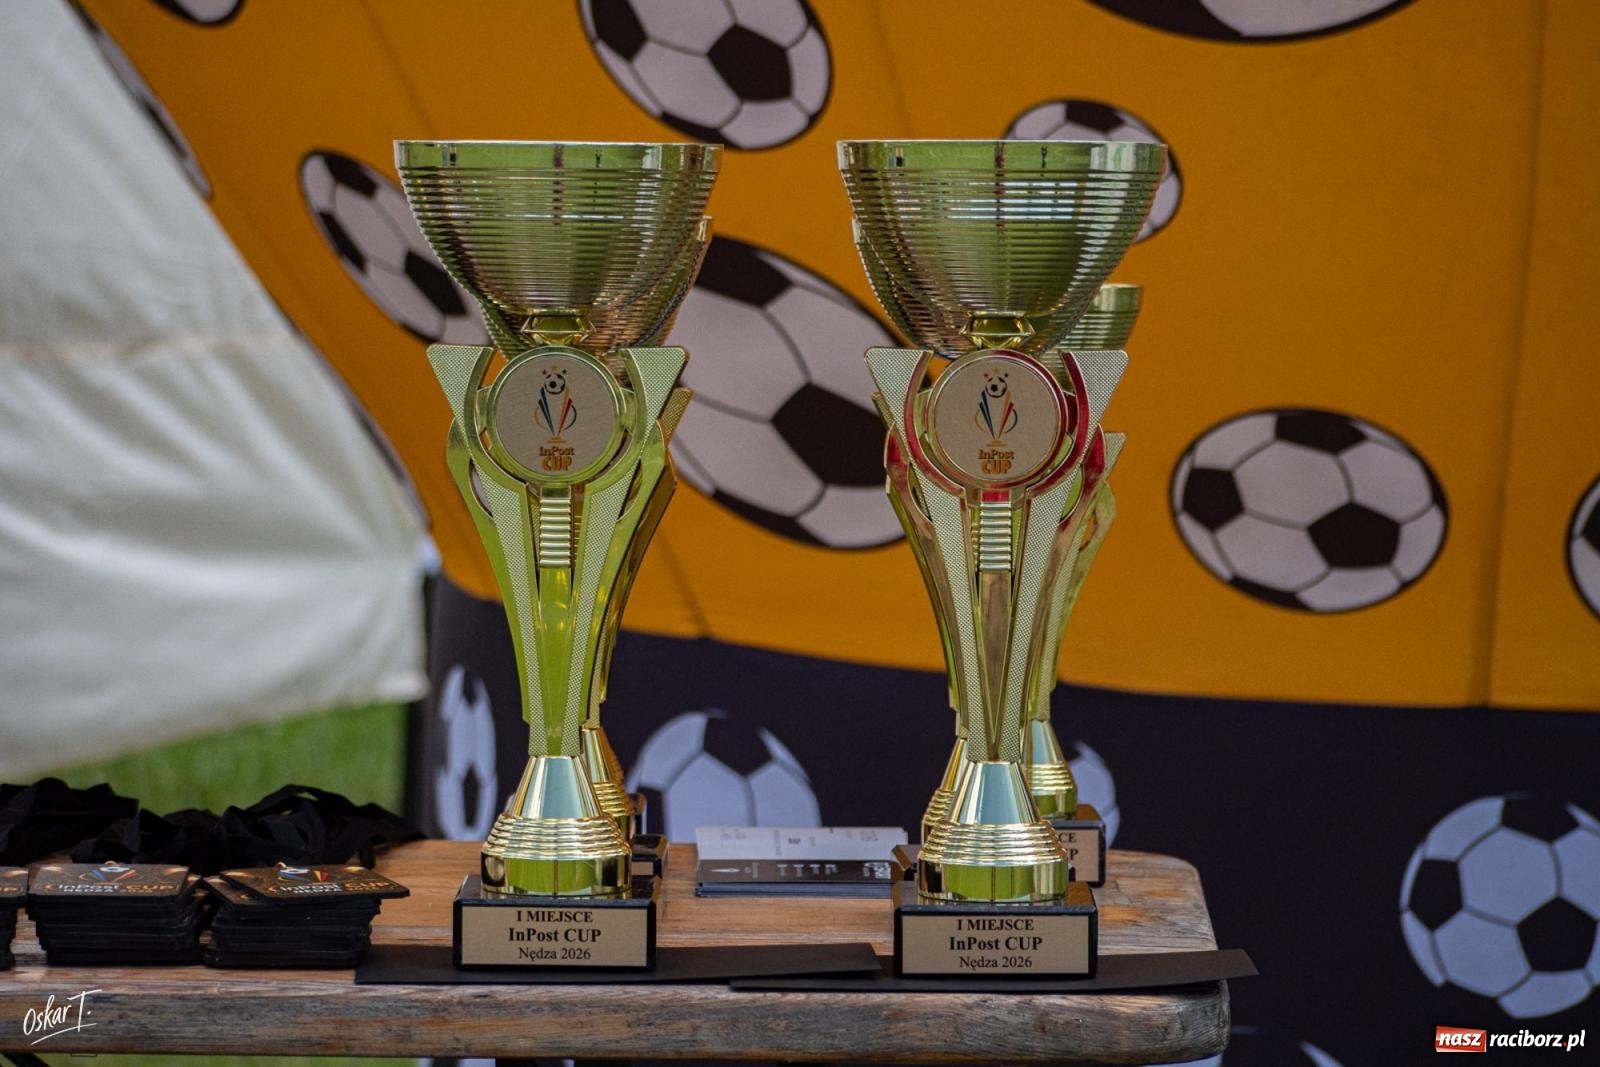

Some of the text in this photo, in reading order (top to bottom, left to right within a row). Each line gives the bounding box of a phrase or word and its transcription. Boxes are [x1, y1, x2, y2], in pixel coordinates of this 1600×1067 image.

[539, 446, 575, 457] InPost
[979, 449, 1015, 459] InPost
[542, 456, 573, 472] CUP
[981, 459, 1012, 475] CUP
[517, 911, 593, 923] I MIEJSCE
[957, 919, 1034, 931] I MIEJSCE
[508, 927, 602, 943] InPost CUP
[949, 936, 1043, 951] InPost CUP
[519, 947, 591, 962] Nędza 2026
[959, 956, 1032, 971] Nędza 2026
